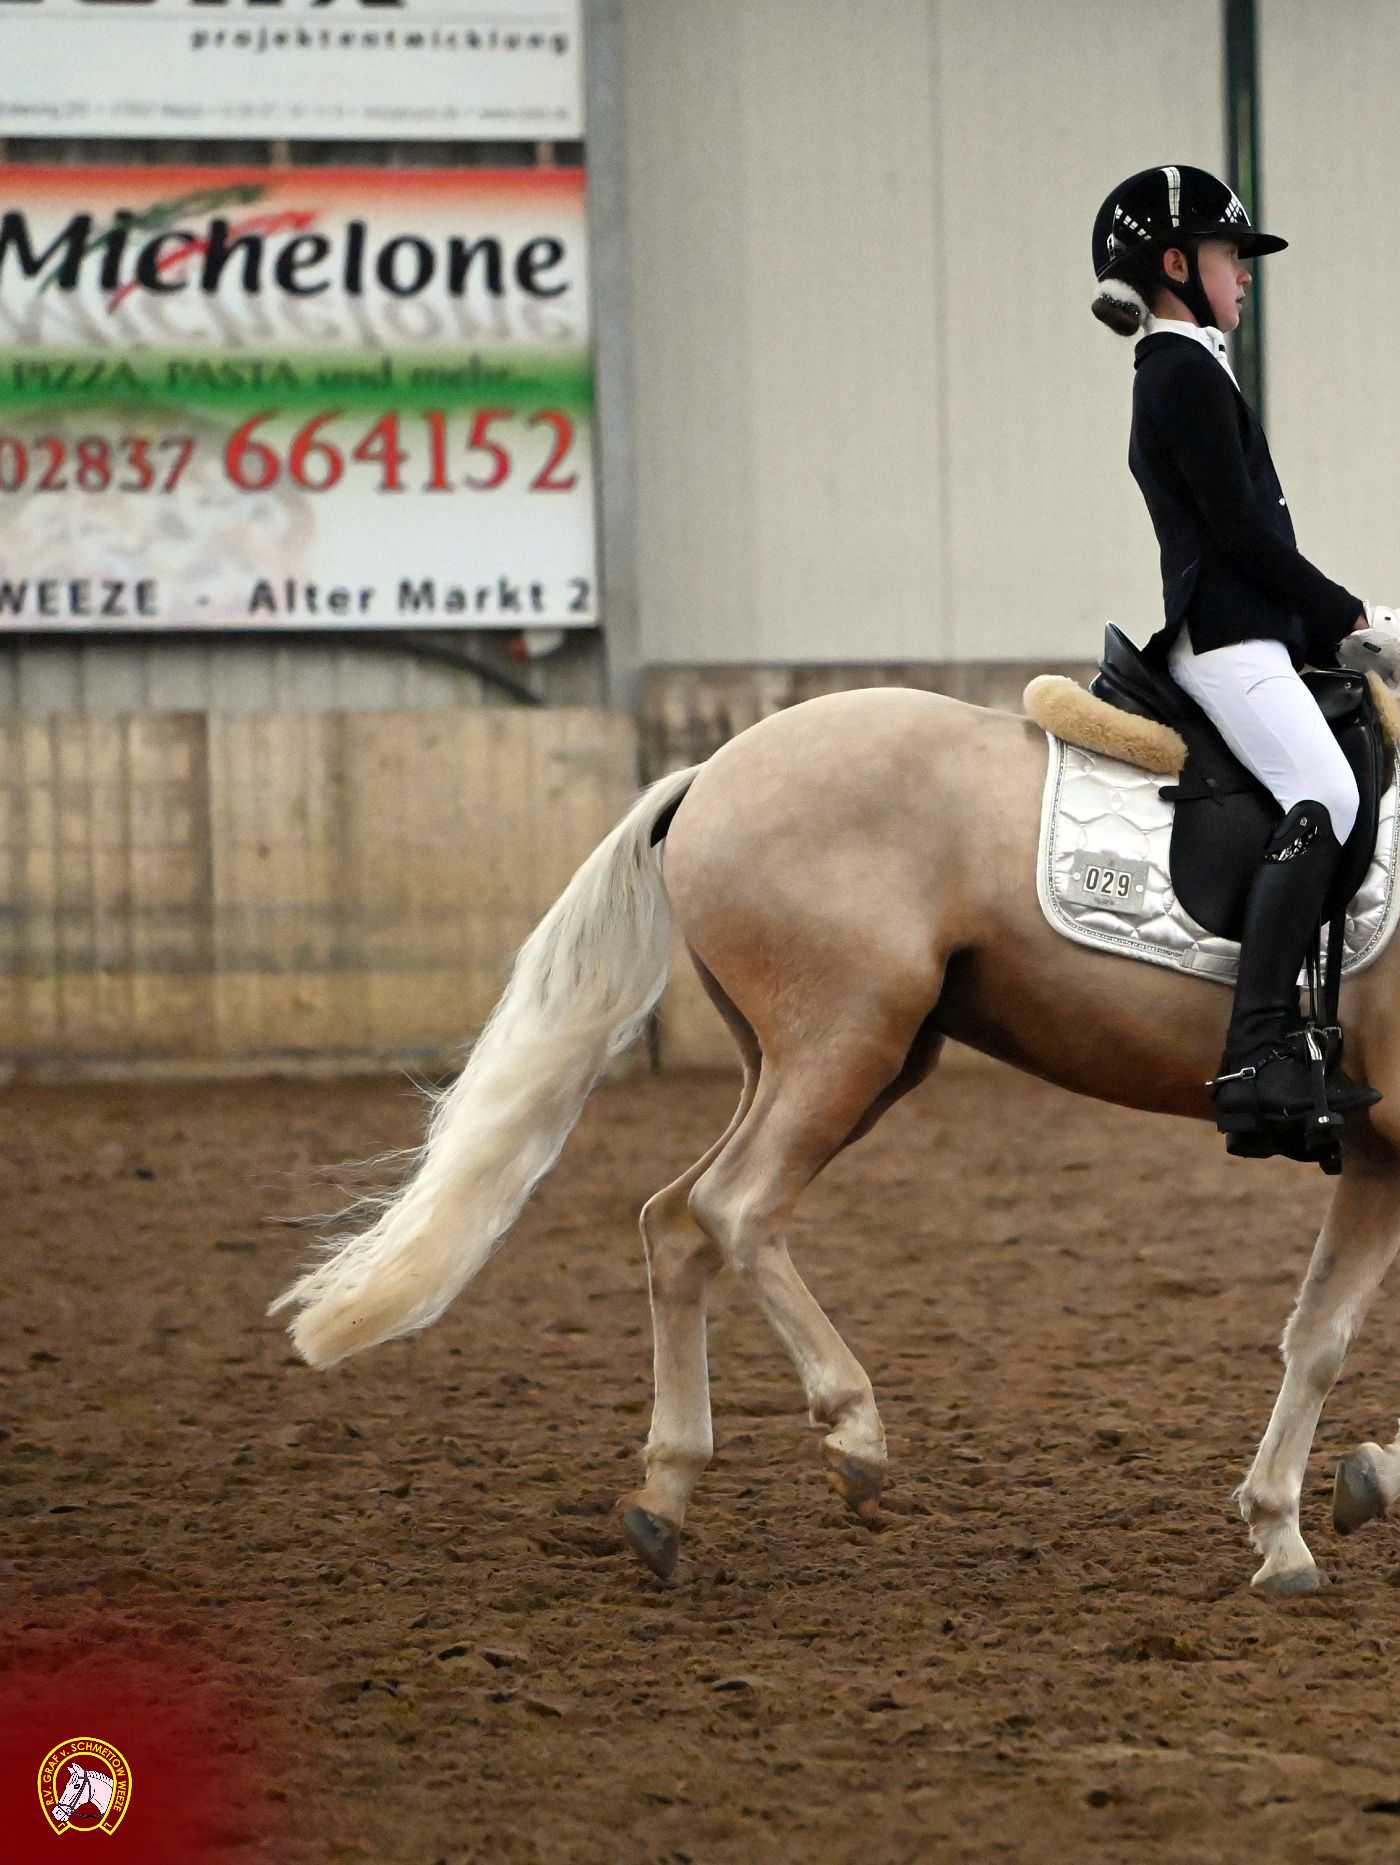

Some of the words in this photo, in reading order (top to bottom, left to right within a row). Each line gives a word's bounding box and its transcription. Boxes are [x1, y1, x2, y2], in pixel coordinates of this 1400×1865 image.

[190, 28, 569, 55] projektentwicklung
[0, 210, 571, 298] Michelone
[12, 357, 139, 391] PIZZA
[166, 357, 300, 391] PASTA
[316, 355, 394, 389] und
[0, 436, 195, 493] 02837
[223, 408, 579, 493] 664152
[0, 579, 160, 616] WEEZE
[248, 579, 375, 614] Alter
[398, 577, 545, 614] Markt
[567, 580, 591, 613] 2
[1086, 868, 1130, 897] 029
